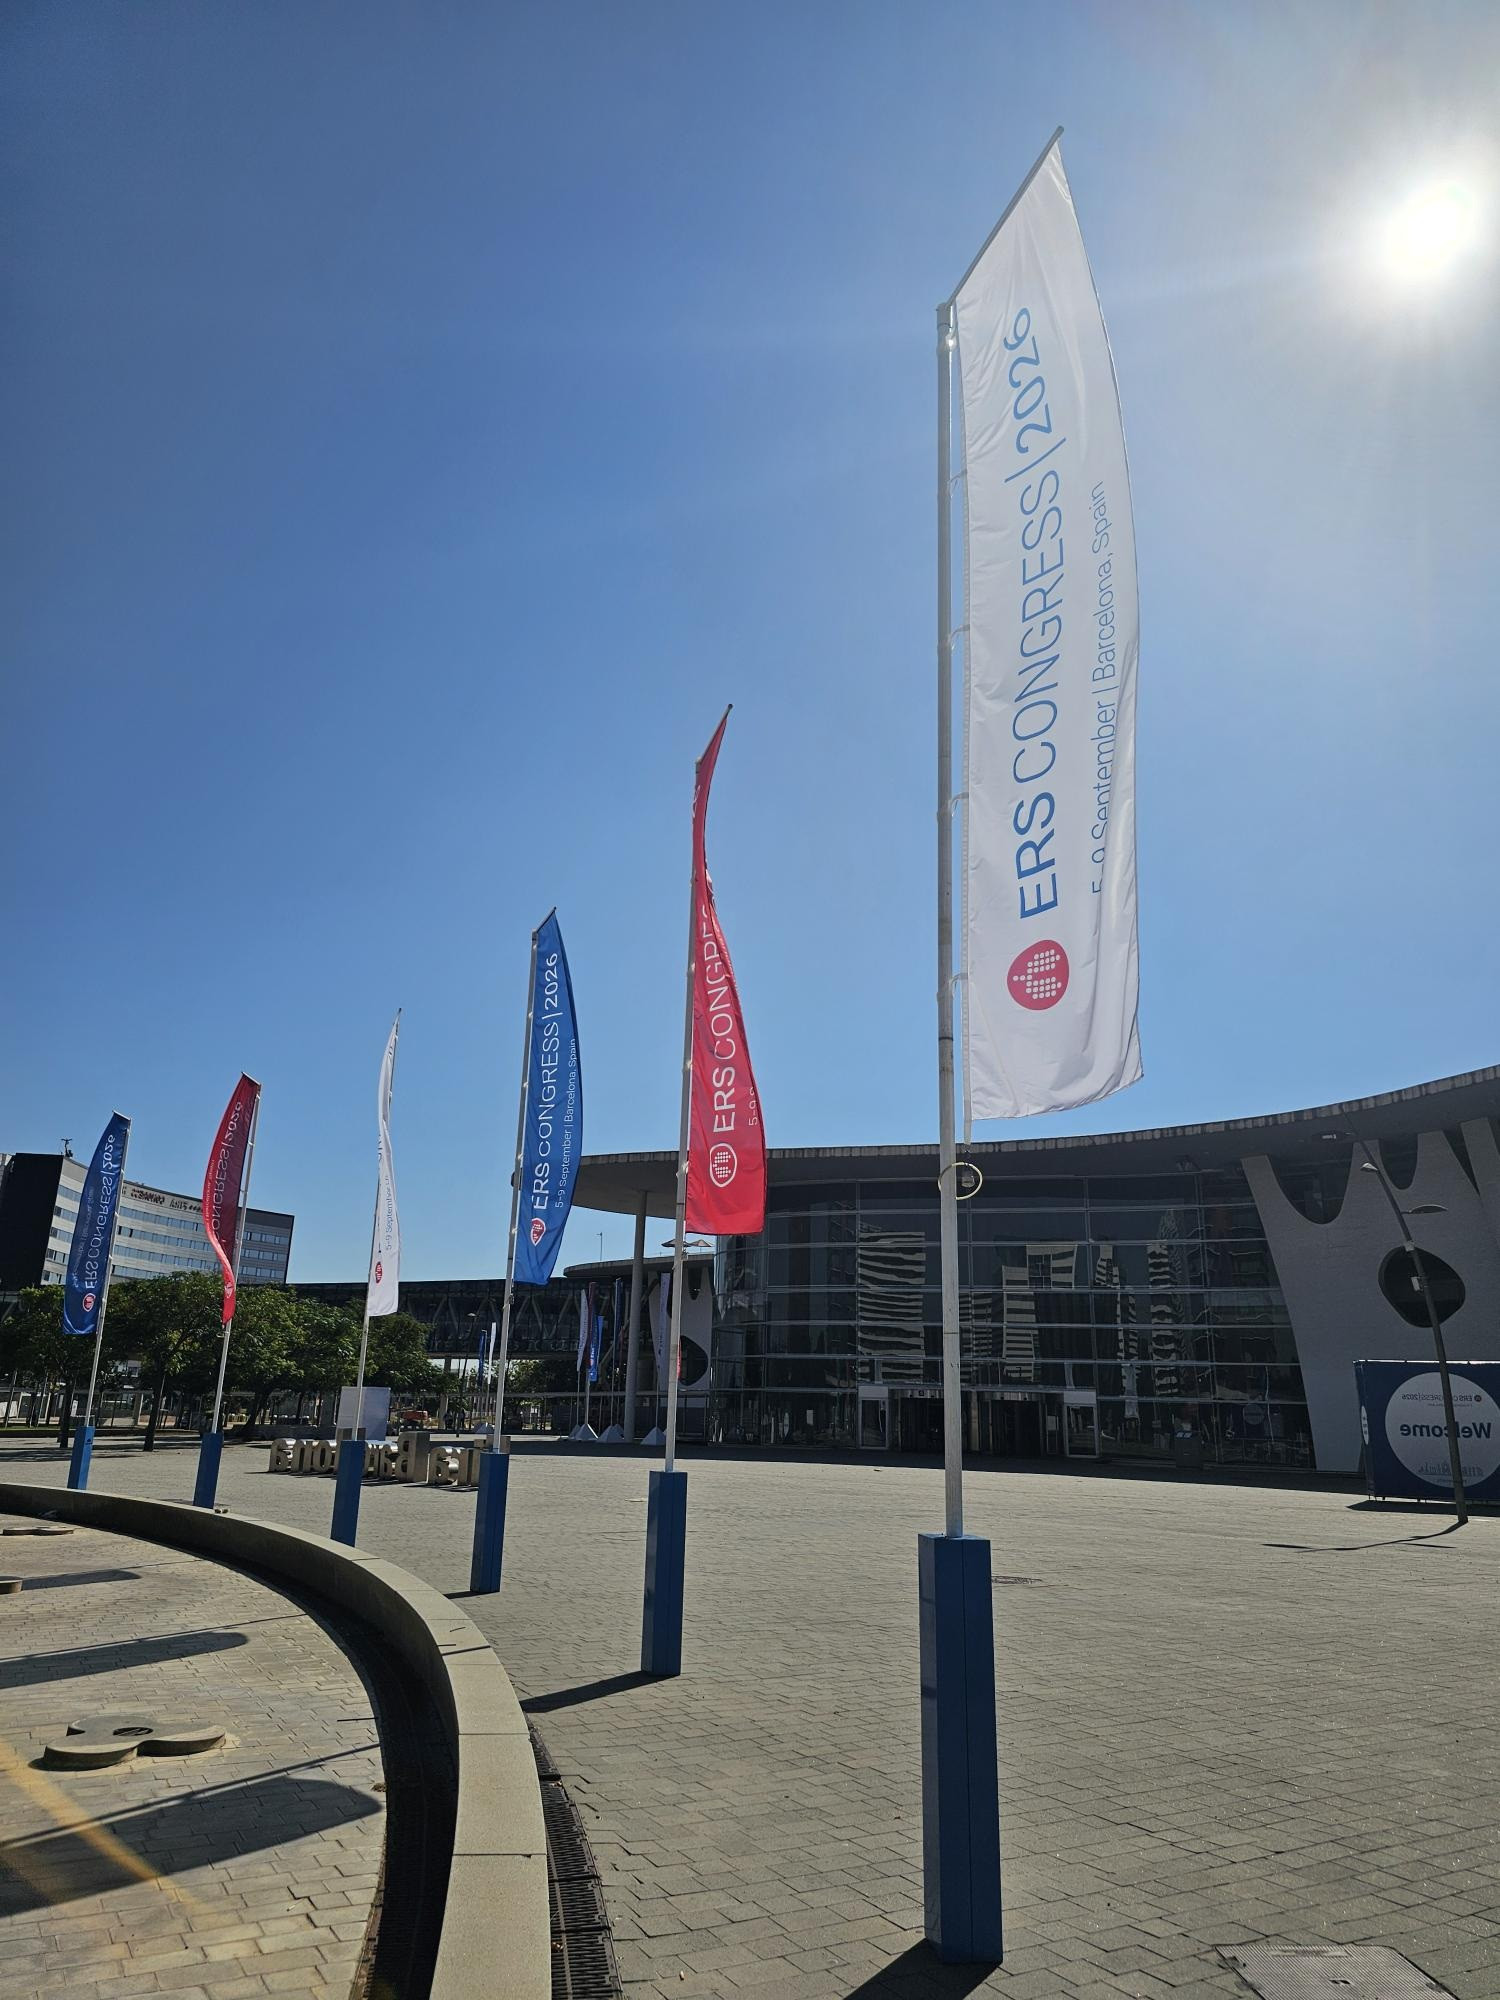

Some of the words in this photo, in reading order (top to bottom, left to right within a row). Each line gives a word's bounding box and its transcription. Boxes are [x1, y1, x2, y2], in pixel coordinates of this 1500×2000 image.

[1003, 307, 1053, 454] 2026
[1088, 481, 1113, 552] Spain
[1012, 469, 1065, 784] CONGRESS
[1092, 551, 1117, 684] Barcelona,
[1013, 791, 1058, 919] ERS
[544, 953, 559, 1010] 2026
[702, 904, 737, 1060] CONGR
[567, 1039, 577, 1067] Spain
[538, 1022, 560, 1157] CONGRESS
[713, 1065, 736, 1133] ERS
[531, 1162, 550, 1210] ERS
[559, 1129, 572, 1187] September
[554, 1189, 566, 1208] 5-9
